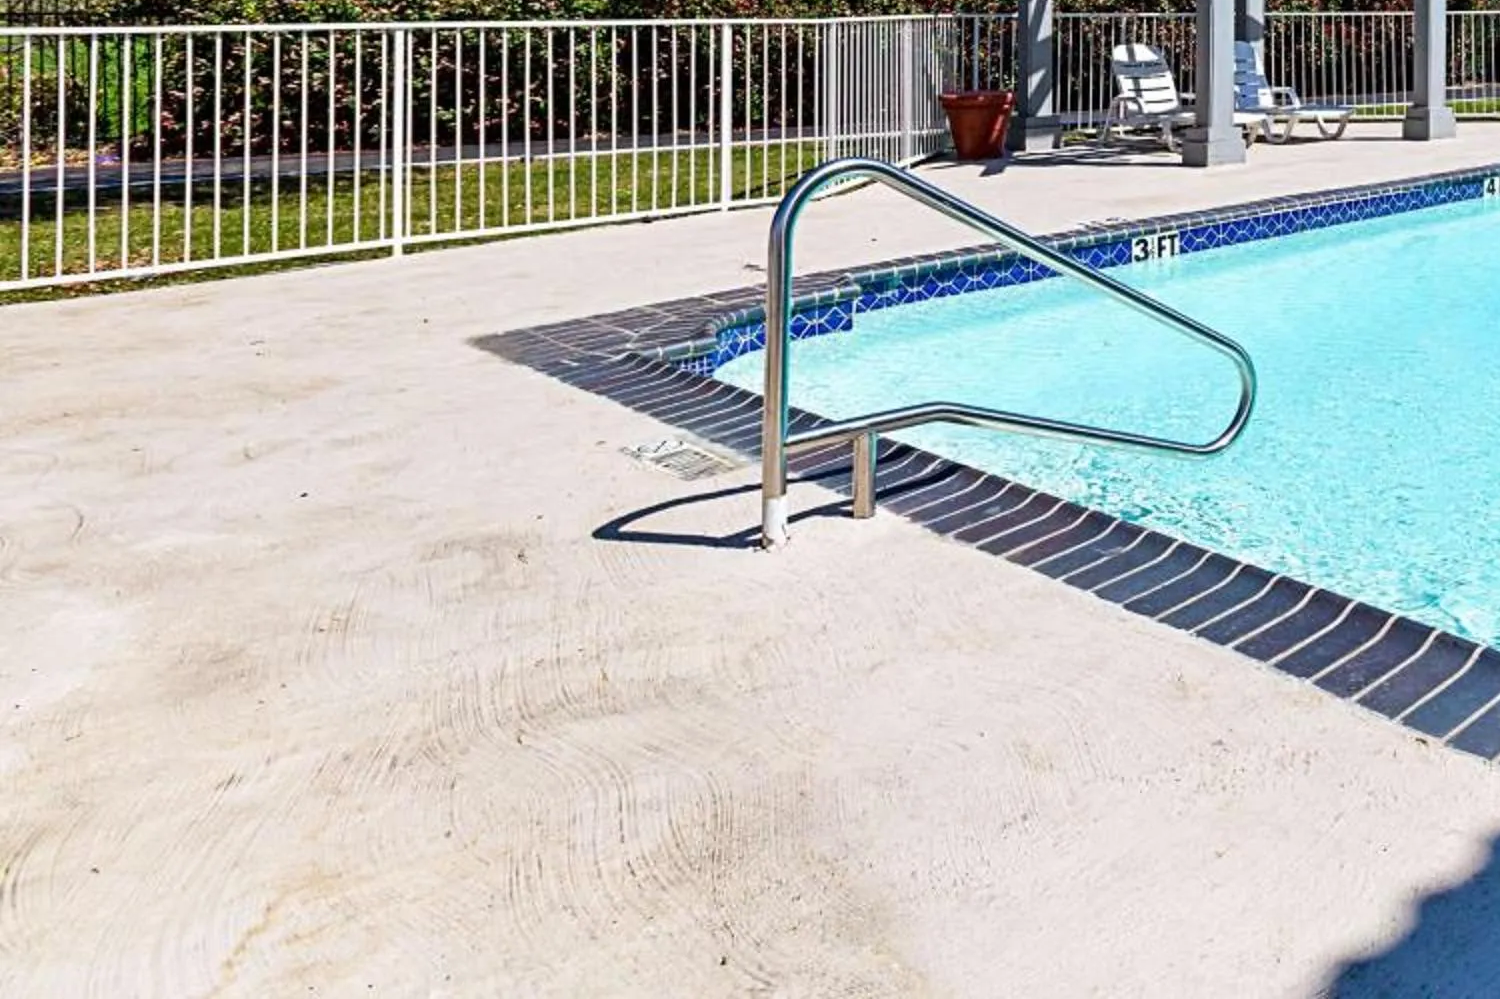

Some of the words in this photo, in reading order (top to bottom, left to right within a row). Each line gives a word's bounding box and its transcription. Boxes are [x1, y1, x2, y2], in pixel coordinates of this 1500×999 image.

[1486, 178, 1496, 195] 4
[1134, 238, 1150, 262] 3
[1157, 234, 1178, 258] FT
